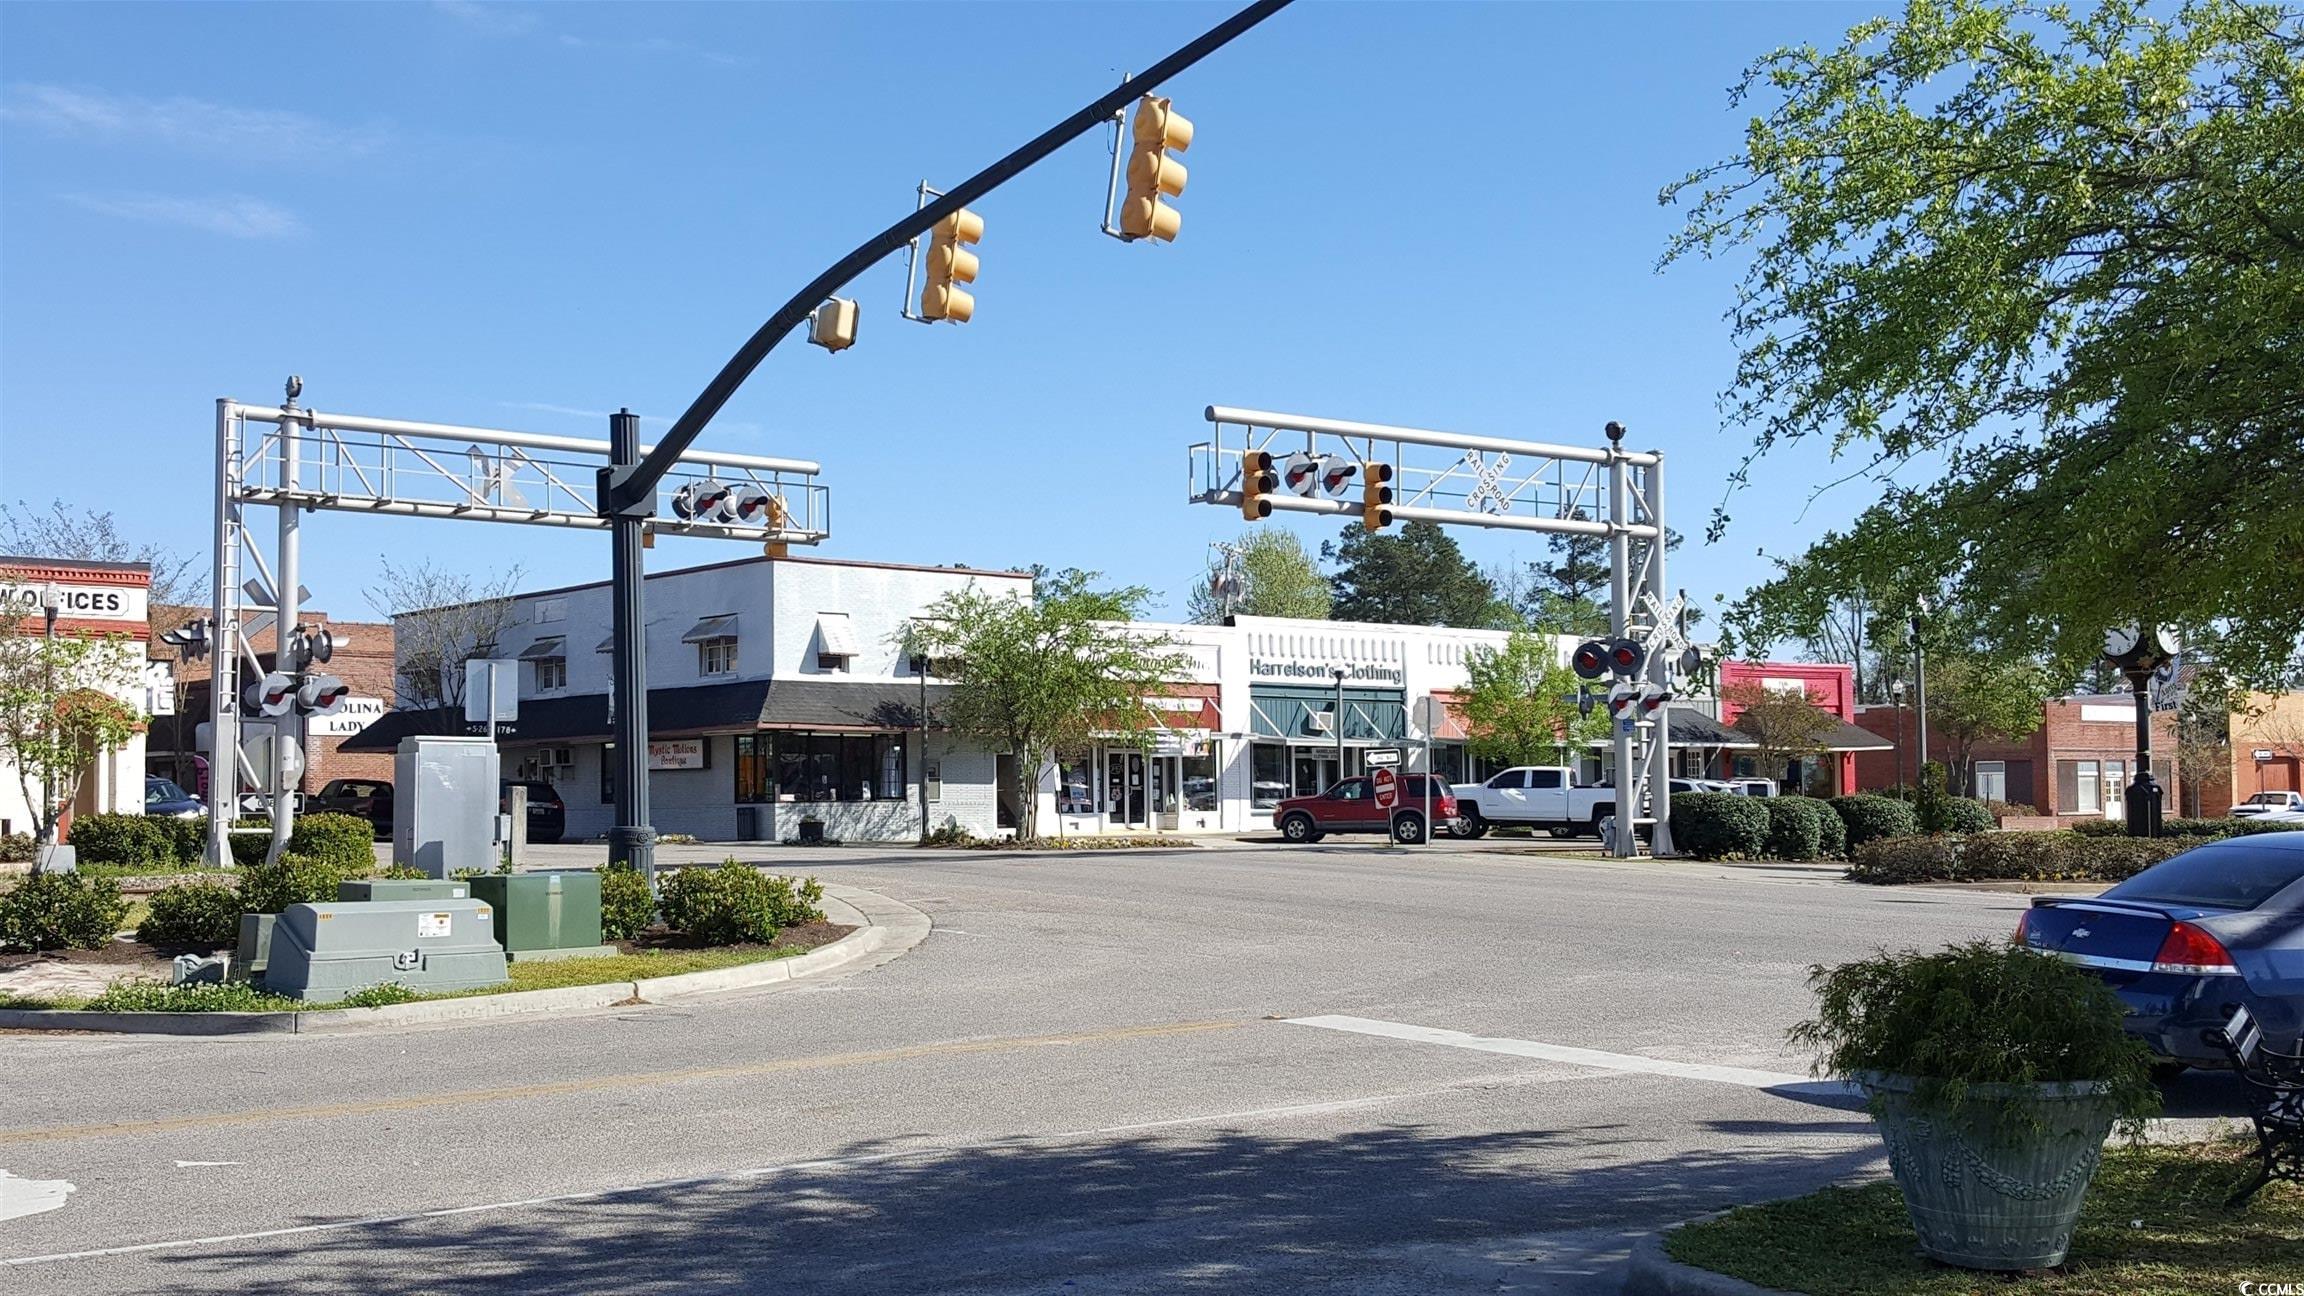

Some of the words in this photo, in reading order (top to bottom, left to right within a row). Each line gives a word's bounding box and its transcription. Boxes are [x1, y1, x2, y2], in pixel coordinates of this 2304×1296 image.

[1466, 450, 1510, 511] RAILROAD
[1467, 454, 1510, 508] CROSSING
[21, 590, 120, 611] OICES
[1647, 593, 1685, 650] RAILROAD
[1648, 597, 1683, 649] CROSSING
[1249, 658, 1335, 679] Harrelson's
[1342, 662, 1402, 685] Clothing
[2154, 700, 2178, 712] First
[330, 721, 365, 732] LADY
